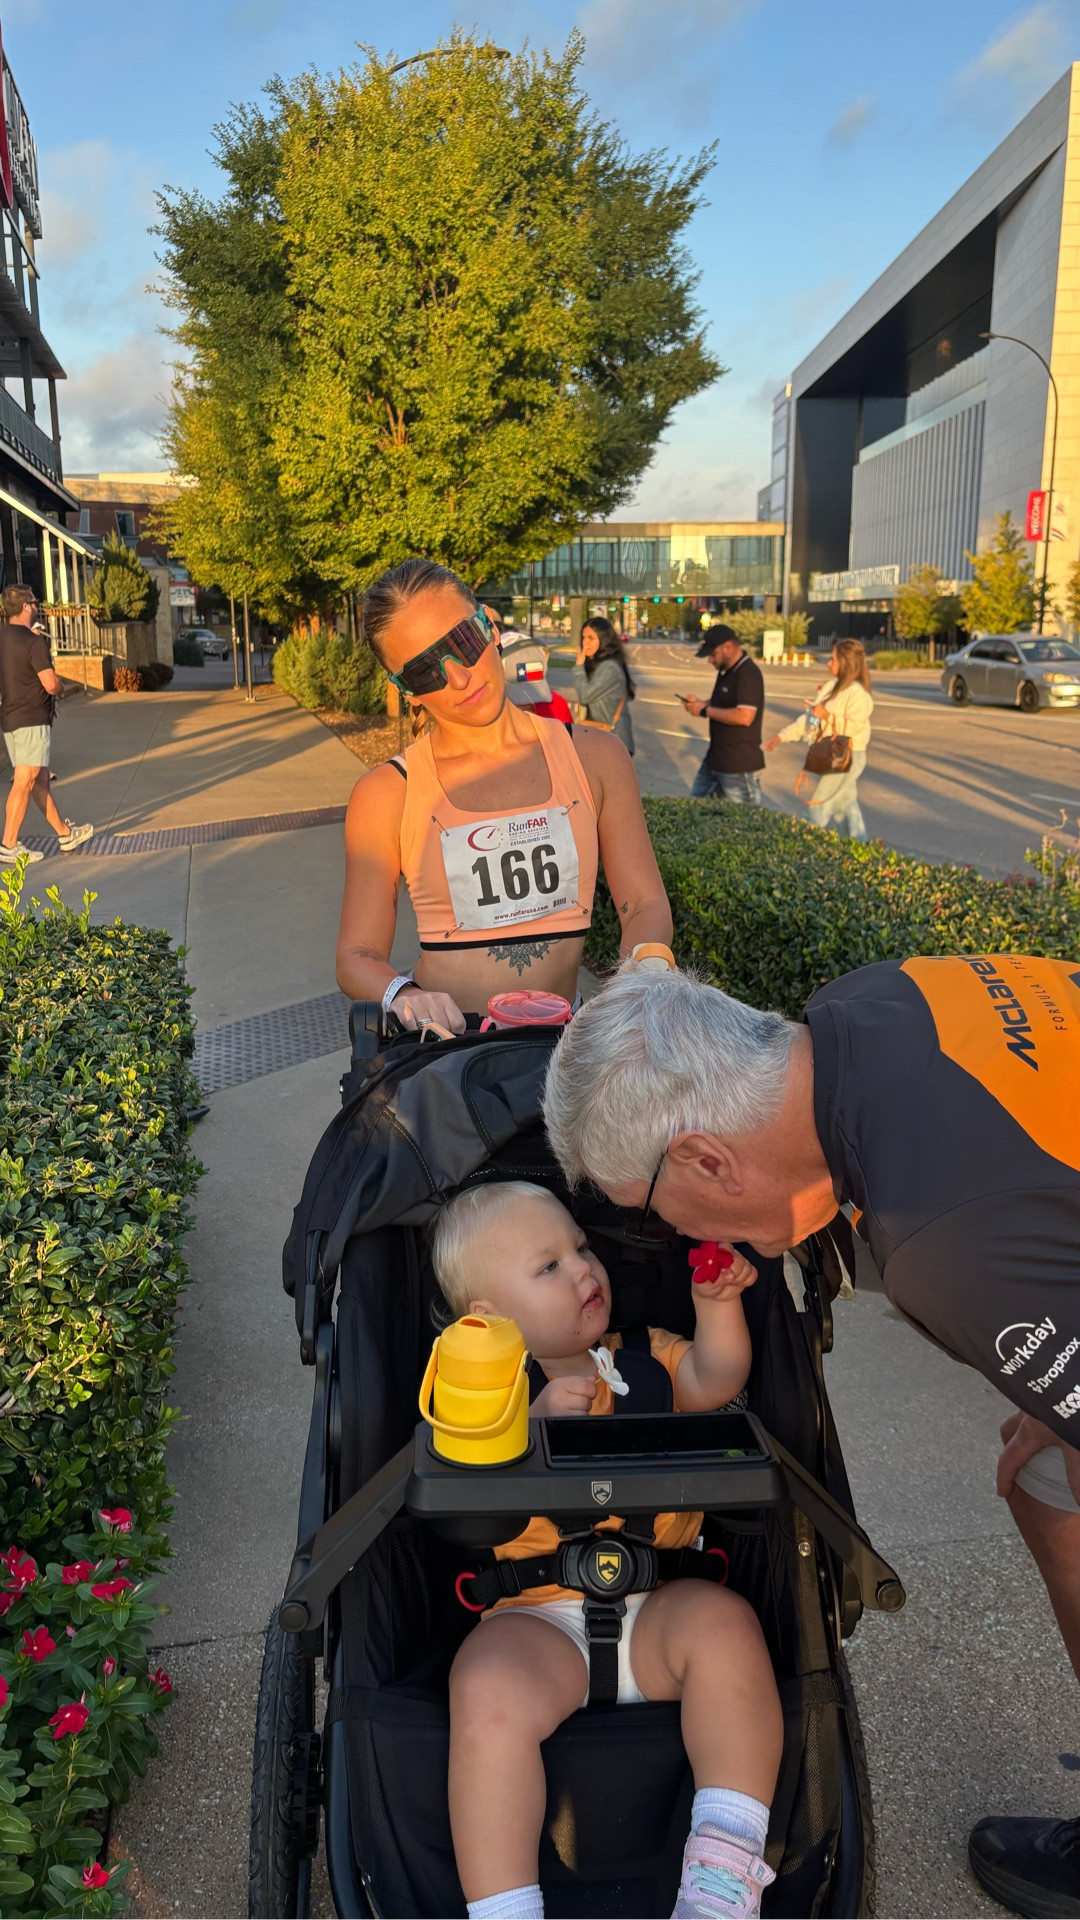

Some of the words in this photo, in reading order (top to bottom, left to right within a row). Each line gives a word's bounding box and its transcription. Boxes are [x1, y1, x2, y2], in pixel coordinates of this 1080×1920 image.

[1031, 496, 1042, 537] WELCOME
[508, 816, 548, 833] RunFAR
[471, 844, 560, 907] 166
[494, 905, 549, 920] www.runfarusa.com
[1001, 954, 1026, 970] TEA
[1030, 984, 1068, 1031] FORMULA
[1000, 1316, 1057, 1376] workday
[1036, 1337, 1080, 1389] Dropbox
